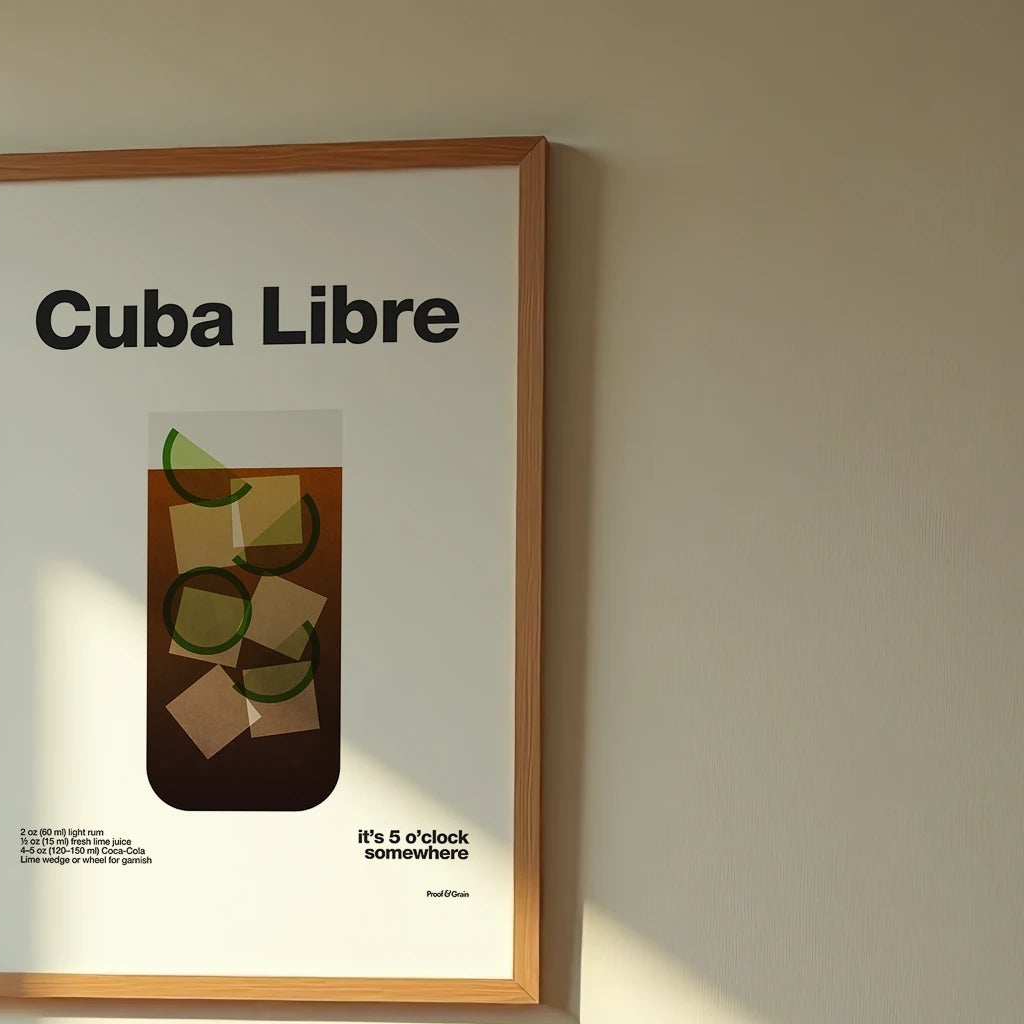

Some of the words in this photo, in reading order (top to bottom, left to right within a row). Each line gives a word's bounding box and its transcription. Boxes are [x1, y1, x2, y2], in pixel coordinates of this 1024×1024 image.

[35, 288, 234, 351] Cuba
[262, 284, 460, 345] Libre
[20, 828, 26, 836] 2
[39, 828, 52, 838] (60
[53, 828, 67, 838] ml)
[68, 828, 86, 837] light
[388, 829, 401, 844] 5
[41, 838, 55, 847] (15
[56, 838, 69, 847] ml)
[70, 838, 92, 846] fresh
[93, 838, 111, 846] lime
[111, 838, 132, 847] juice
[86, 847, 100, 856] ml)
[101, 847, 146, 855] Coca-Cola
[364, 845, 469, 860] somewhere
[20, 856, 41, 864] Lime
[41, 856, 70, 865] wedge
[82, 856, 107, 864] wheel
[108, 856, 120, 864] for
[121, 856, 153, 865] garnish
